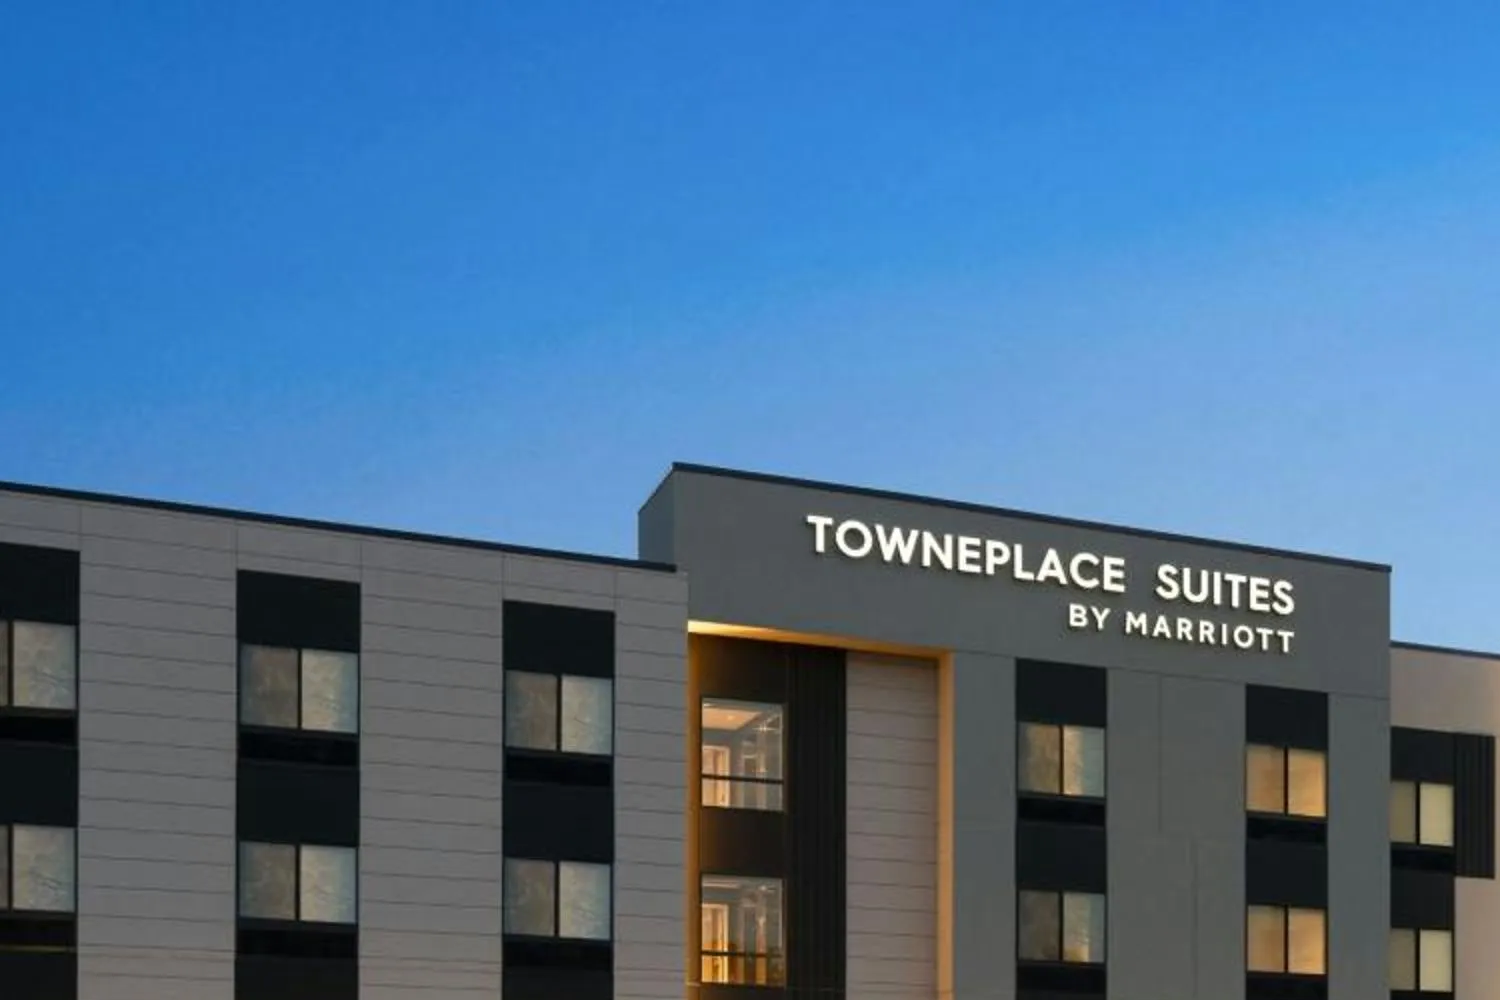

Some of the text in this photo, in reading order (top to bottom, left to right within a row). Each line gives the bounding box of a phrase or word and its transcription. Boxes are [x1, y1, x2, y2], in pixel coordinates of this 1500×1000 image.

[806, 514, 1296, 616] TOWNEPLACE SUITES
[1068, 602, 1296, 654] BY MARRIOTT
